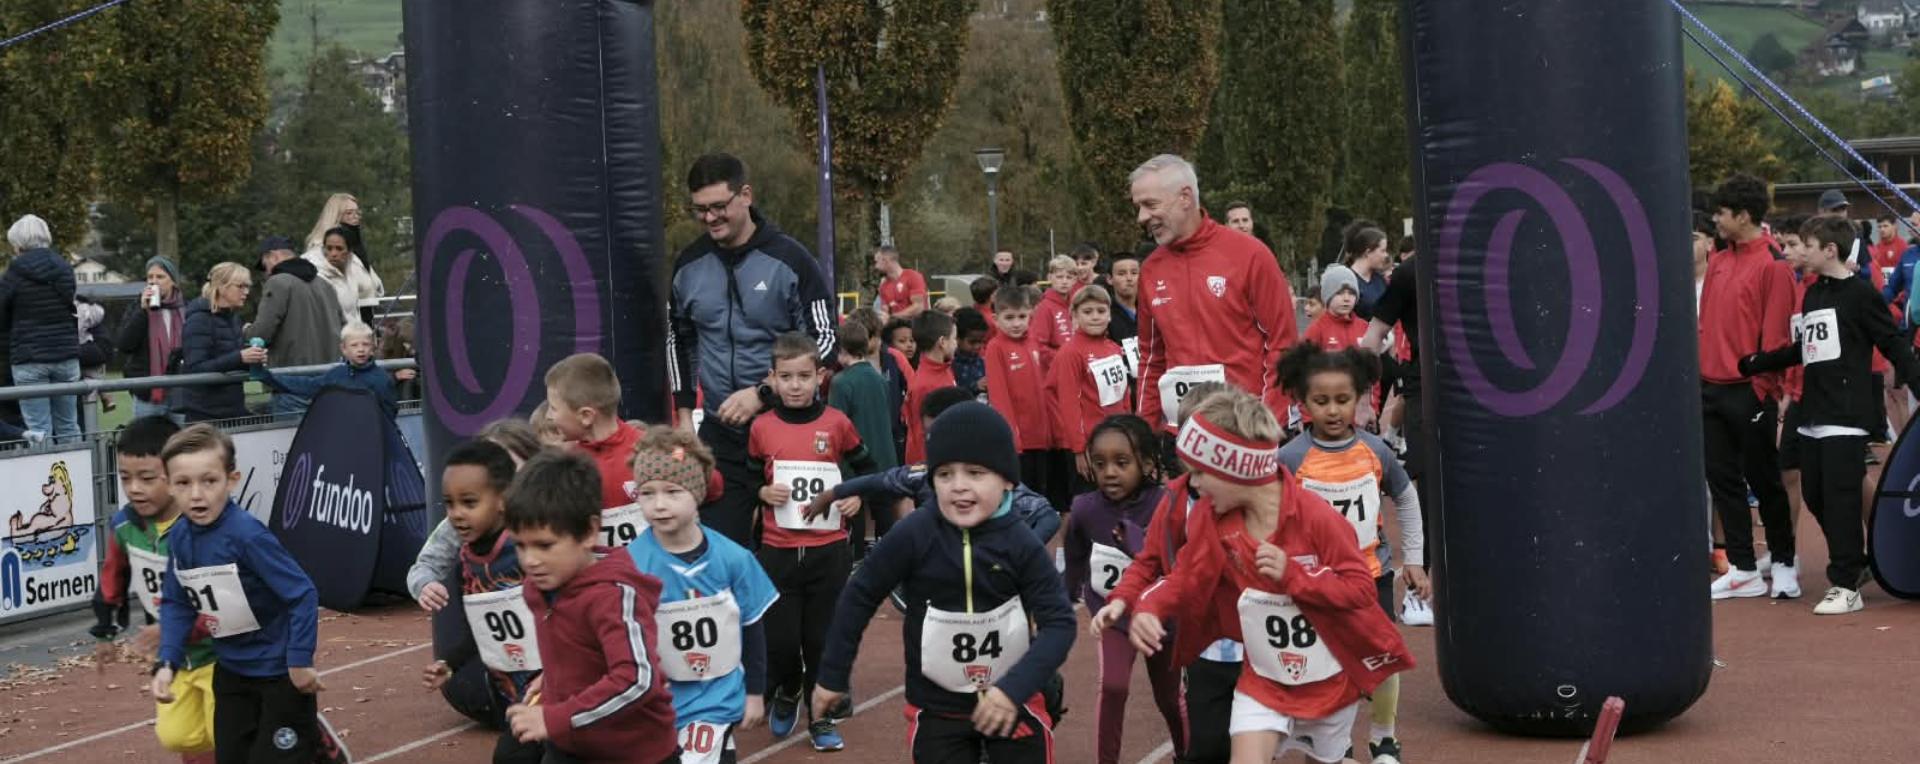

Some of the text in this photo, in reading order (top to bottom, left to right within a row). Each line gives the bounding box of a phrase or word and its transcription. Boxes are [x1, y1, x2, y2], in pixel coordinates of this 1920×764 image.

[1806, 322, 1829, 342] 78
[1102, 366, 1123, 386] 155
[1175, 381, 1202, 403] 9
[1183, 427, 1277, 477] FC SARNE
[309, 464, 372, 535] fundoo
[792, 477, 824, 502] 89
[1327, 494, 1365, 522] 71
[599, 522, 637, 547] 79
[26, 574, 95, 605] Sarnen
[142, 567, 165, 593] 8
[1104, 564, 1126, 590] 2
[183, 585, 218, 611] 91
[485, 610, 525, 642] 90
[672, 617, 718, 651] 80
[1265, 613, 1317, 649] 98
[952, 630, 1003, 663] 84
[684, 722, 715, 754] 10
